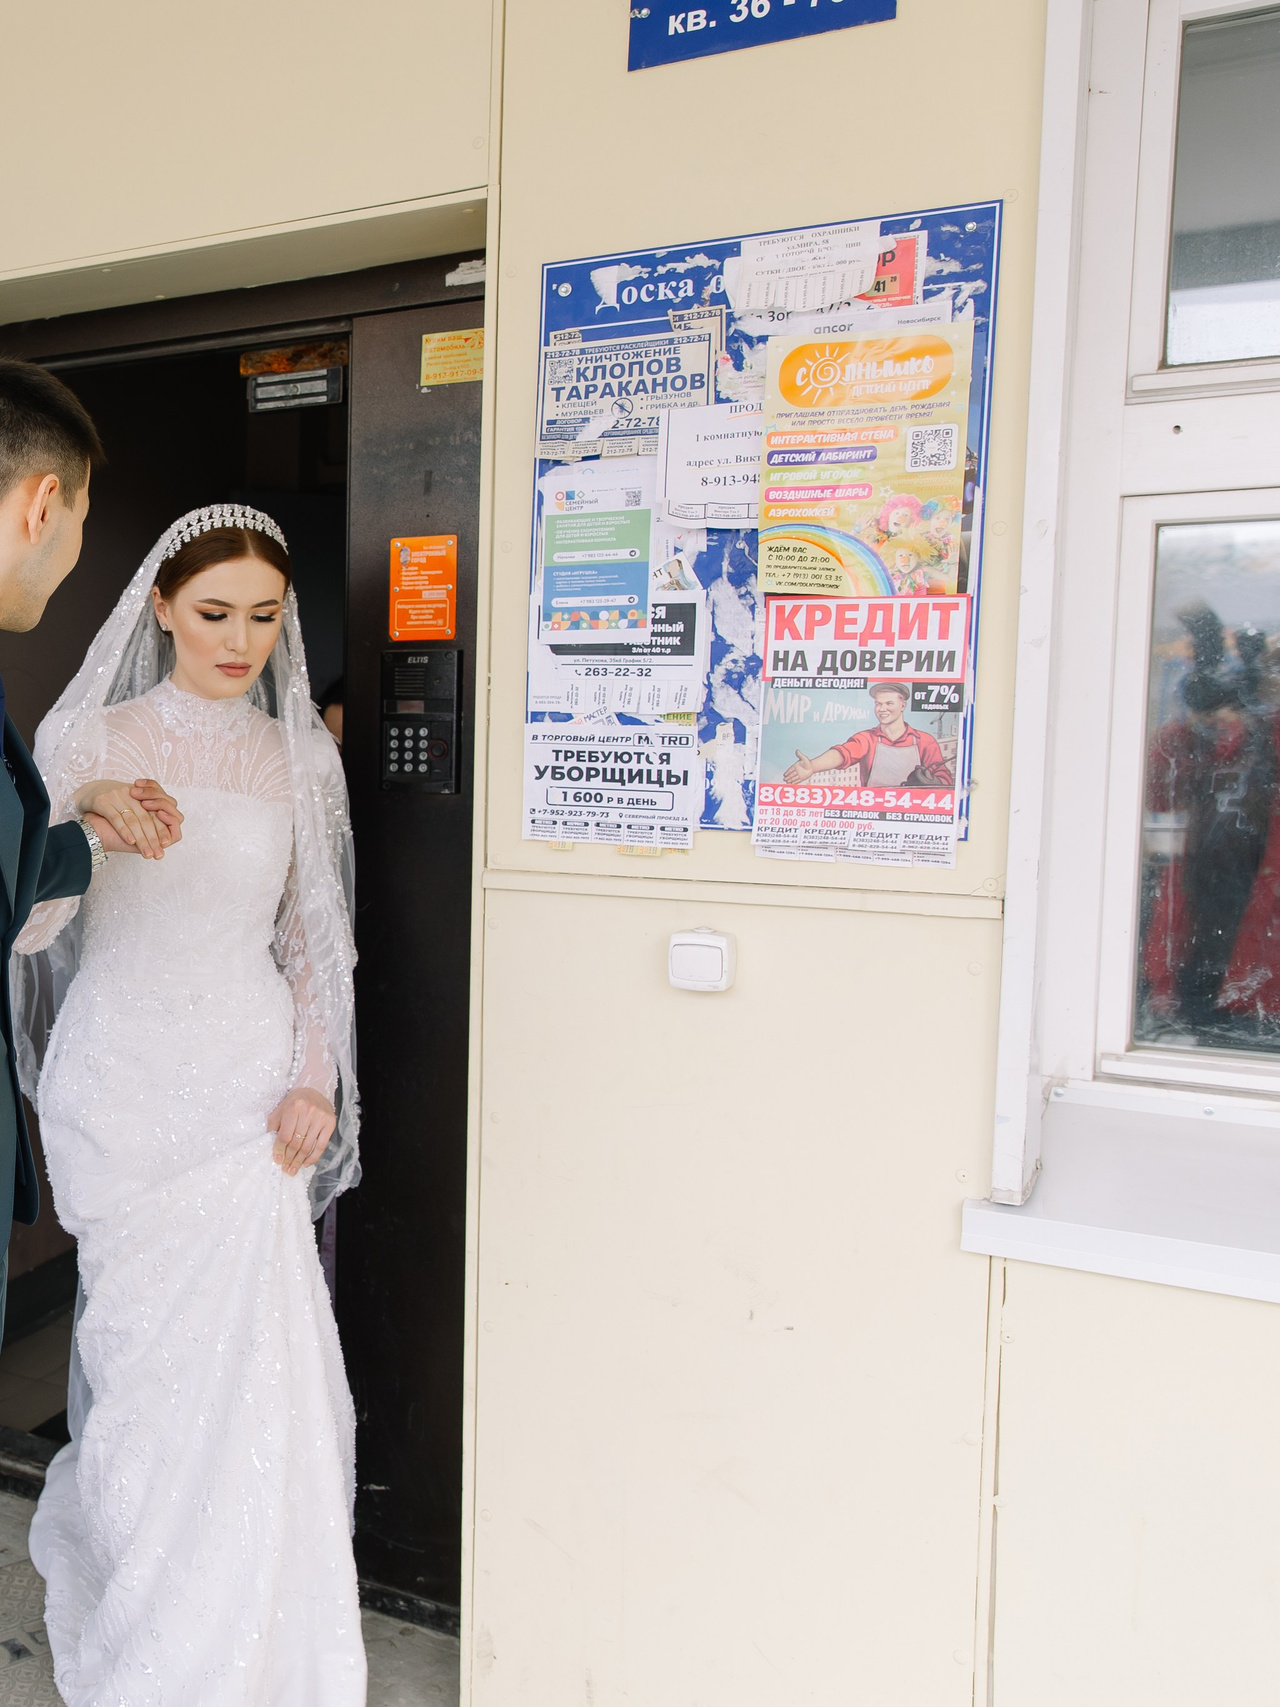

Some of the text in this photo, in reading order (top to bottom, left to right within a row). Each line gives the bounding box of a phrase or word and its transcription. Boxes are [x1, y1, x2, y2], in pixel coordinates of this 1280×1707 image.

[668, 9, 716, 35] кв.
[759, 226, 860, 246] ТРЕБУЮТСЯ ОХРАННИКИ
[756, 266, 781, 276] СУТКИ
[898, 316, 941, 325] Новосибирск
[814, 322, 854, 335] ancor
[586, 333, 710, 354] ТРЕБУЮТСЯ РАСКЛЕЙЩИКИ 212-72-78
[577, 347, 681, 366] УНИЧТОЖЕНИЕ
[576, 357, 682, 383] КЛОПОВ
[551, 373, 706, 402] ТАРАКАНОВ
[646, 392, 692, 402] ГРЫЗУНОВ
[561, 401, 597, 411] КЛЕЩЕЙ
[646, 402, 677, 410] ГРИБКА
[776, 401, 951, 419] ПРИГЛАШАЕМ ОТПРАЗДНОВАТЬ ДЕНЬ РОЖДЕНИЯ
[561, 408, 604, 418] МУРАВЬЕВ
[791, 410, 934, 427] ИЛИ ПРОСТО ВЕСЕЛО ПРОВЕСТИ ВРЕМЯ!
[770, 429, 894, 446] ИНТЕРАКТИВНАЯ СТЕНА
[686, 458, 714, 468] адрес
[717, 457, 732, 468] ул.
[770, 449, 874, 465] ДЕТСКИЙ ЛАБИРИНТ
[770, 467, 862, 482] ИГРОВОЙ УГОЛОК
[769, 486, 869, 501] ВОЗДУШНЫЕ ШАРЫ
[565, 498, 598, 506] СЕМЕЙНЫЙ
[768, 506, 836, 518] АЭРОХОККЕЙ
[767, 545, 790, 553] ЖДЁМ
[775, 554, 796, 562] 10:00
[793, 572, 809, 580] (913)
[774, 603, 960, 647] КРЕДИТ
[772, 649, 957, 676] НА ДОВЕРИИ
[584, 667, 652, 677] 263-22-32
[773, 677, 865, 689] ДЕНЬГИ СЕГОДНЯ!
[914, 684, 960, 704] от 7%
[542, 733, 596, 743] ТОРГОВЫЙ
[598, 735, 632, 744] ЦЕНТР
[638, 735, 690, 746] MTRO
[534, 765, 690, 788] УБОРЩИЦЫ
[561, 791, 568, 802] 1
[573, 791, 605, 803] 600
[627, 797, 658, 807] ДЕНЬ
[759, 785, 954, 812] 8(383)248-54-44
[537, 809, 611, 819] +7-952-923-79-73
[771, 808, 781, 817] 18
[783, 809, 795, 819] до
[797, 809, 807, 818] 85
[809, 811, 824, 819] лет
[825, 809, 840, 819] БЕЗ
[842, 810, 880, 820] СПРАВОК
[886, 812, 901, 822] БЕЗ
[903, 814, 953, 825] СТРАХОВОК
[756, 825, 799, 834] КРЕДИТ
[770, 818, 780, 827] 20
[781, 818, 797, 828] 000
[800, 819, 811, 829] до
[813, 820, 819, 828] 4
[821, 820, 836, 830] 000
[839, 821, 855, 830] 000
[857, 822, 875, 832] руб.
[804, 828, 848, 836] КРЕДИТ
[855, 831, 901, 840] КРЕДИТ
[904, 833, 950, 842] КРЕДИТ
